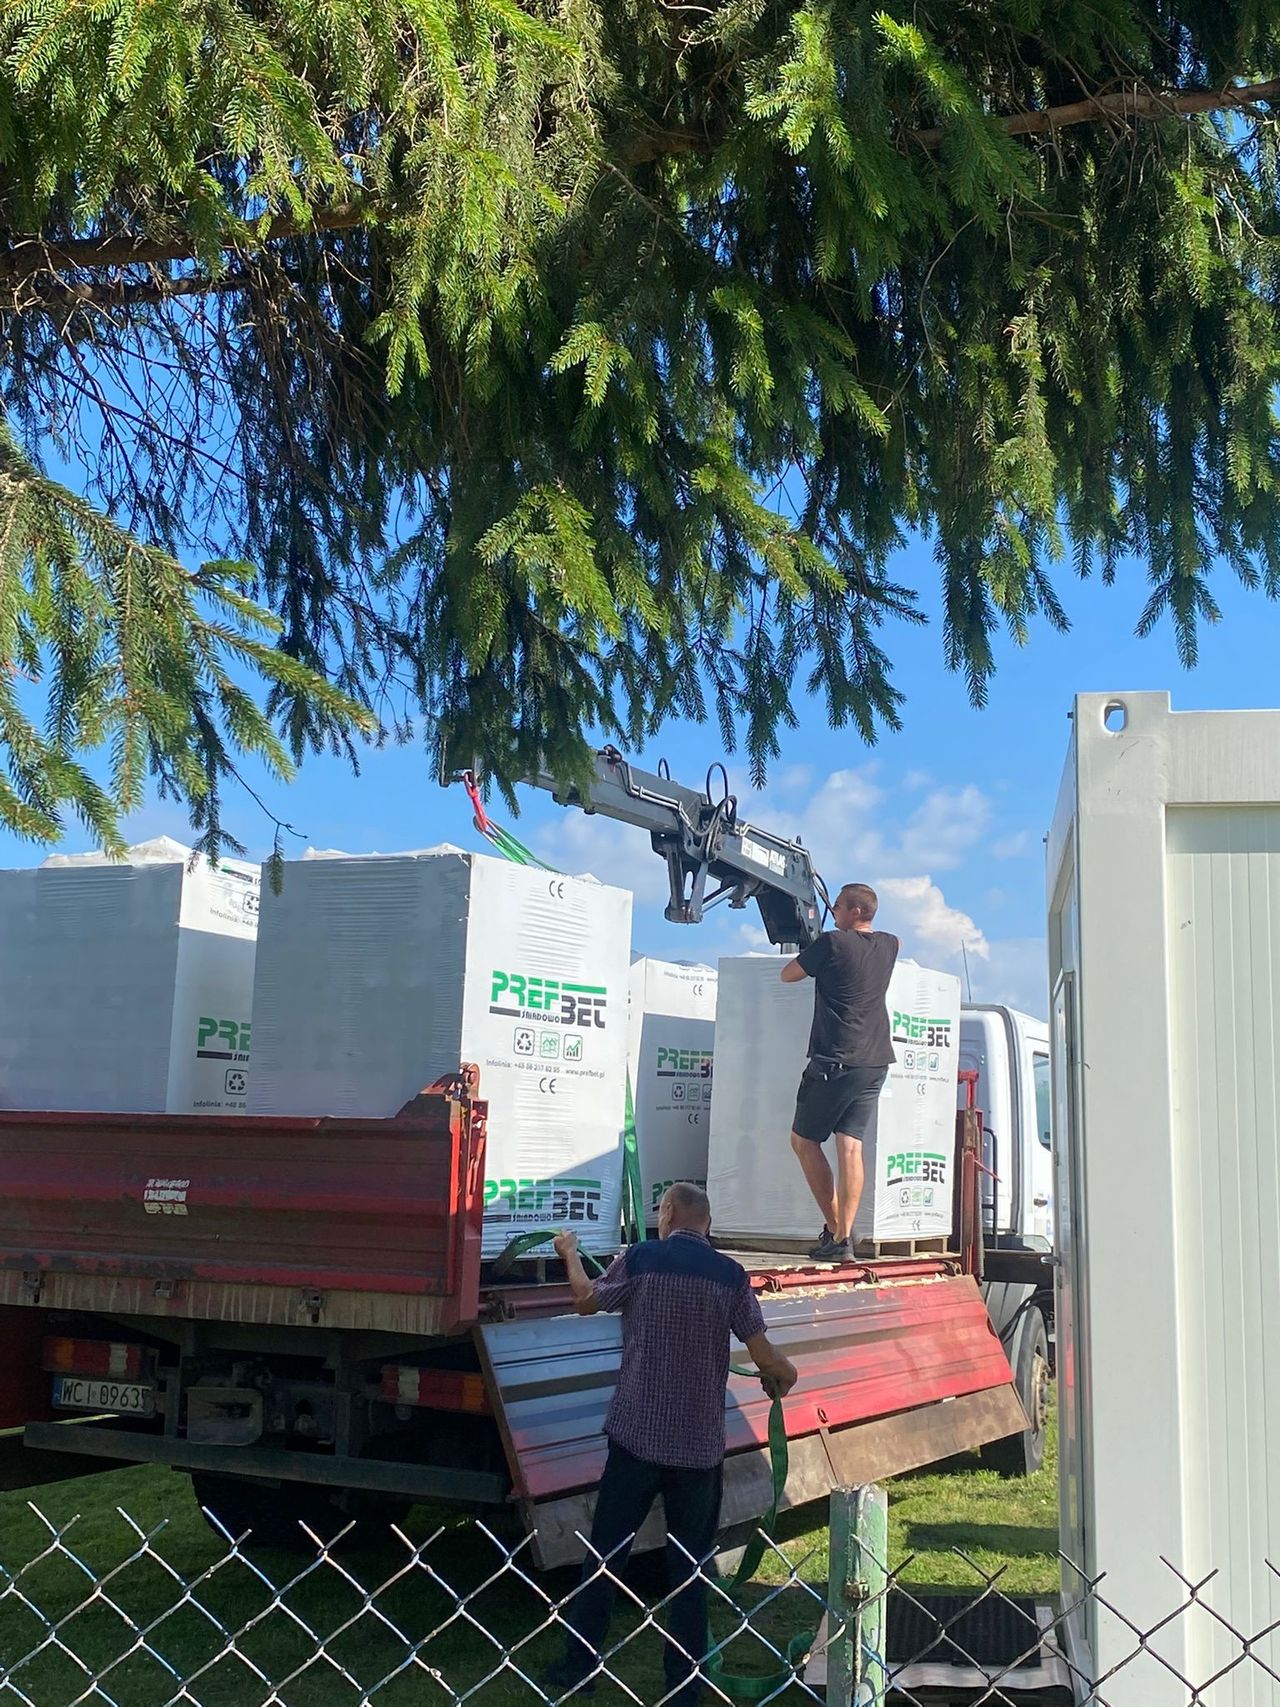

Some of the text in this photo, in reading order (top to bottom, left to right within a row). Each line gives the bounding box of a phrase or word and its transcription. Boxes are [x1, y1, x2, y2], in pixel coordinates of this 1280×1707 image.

[490, 970, 607, 1029] PREFBET
[893, 1010, 951, 1047] PREFBET
[540, 1077, 557, 1094] CE
[887, 1153, 946, 1184] PREFBET
[483, 1179, 601, 1221] PREFBET
